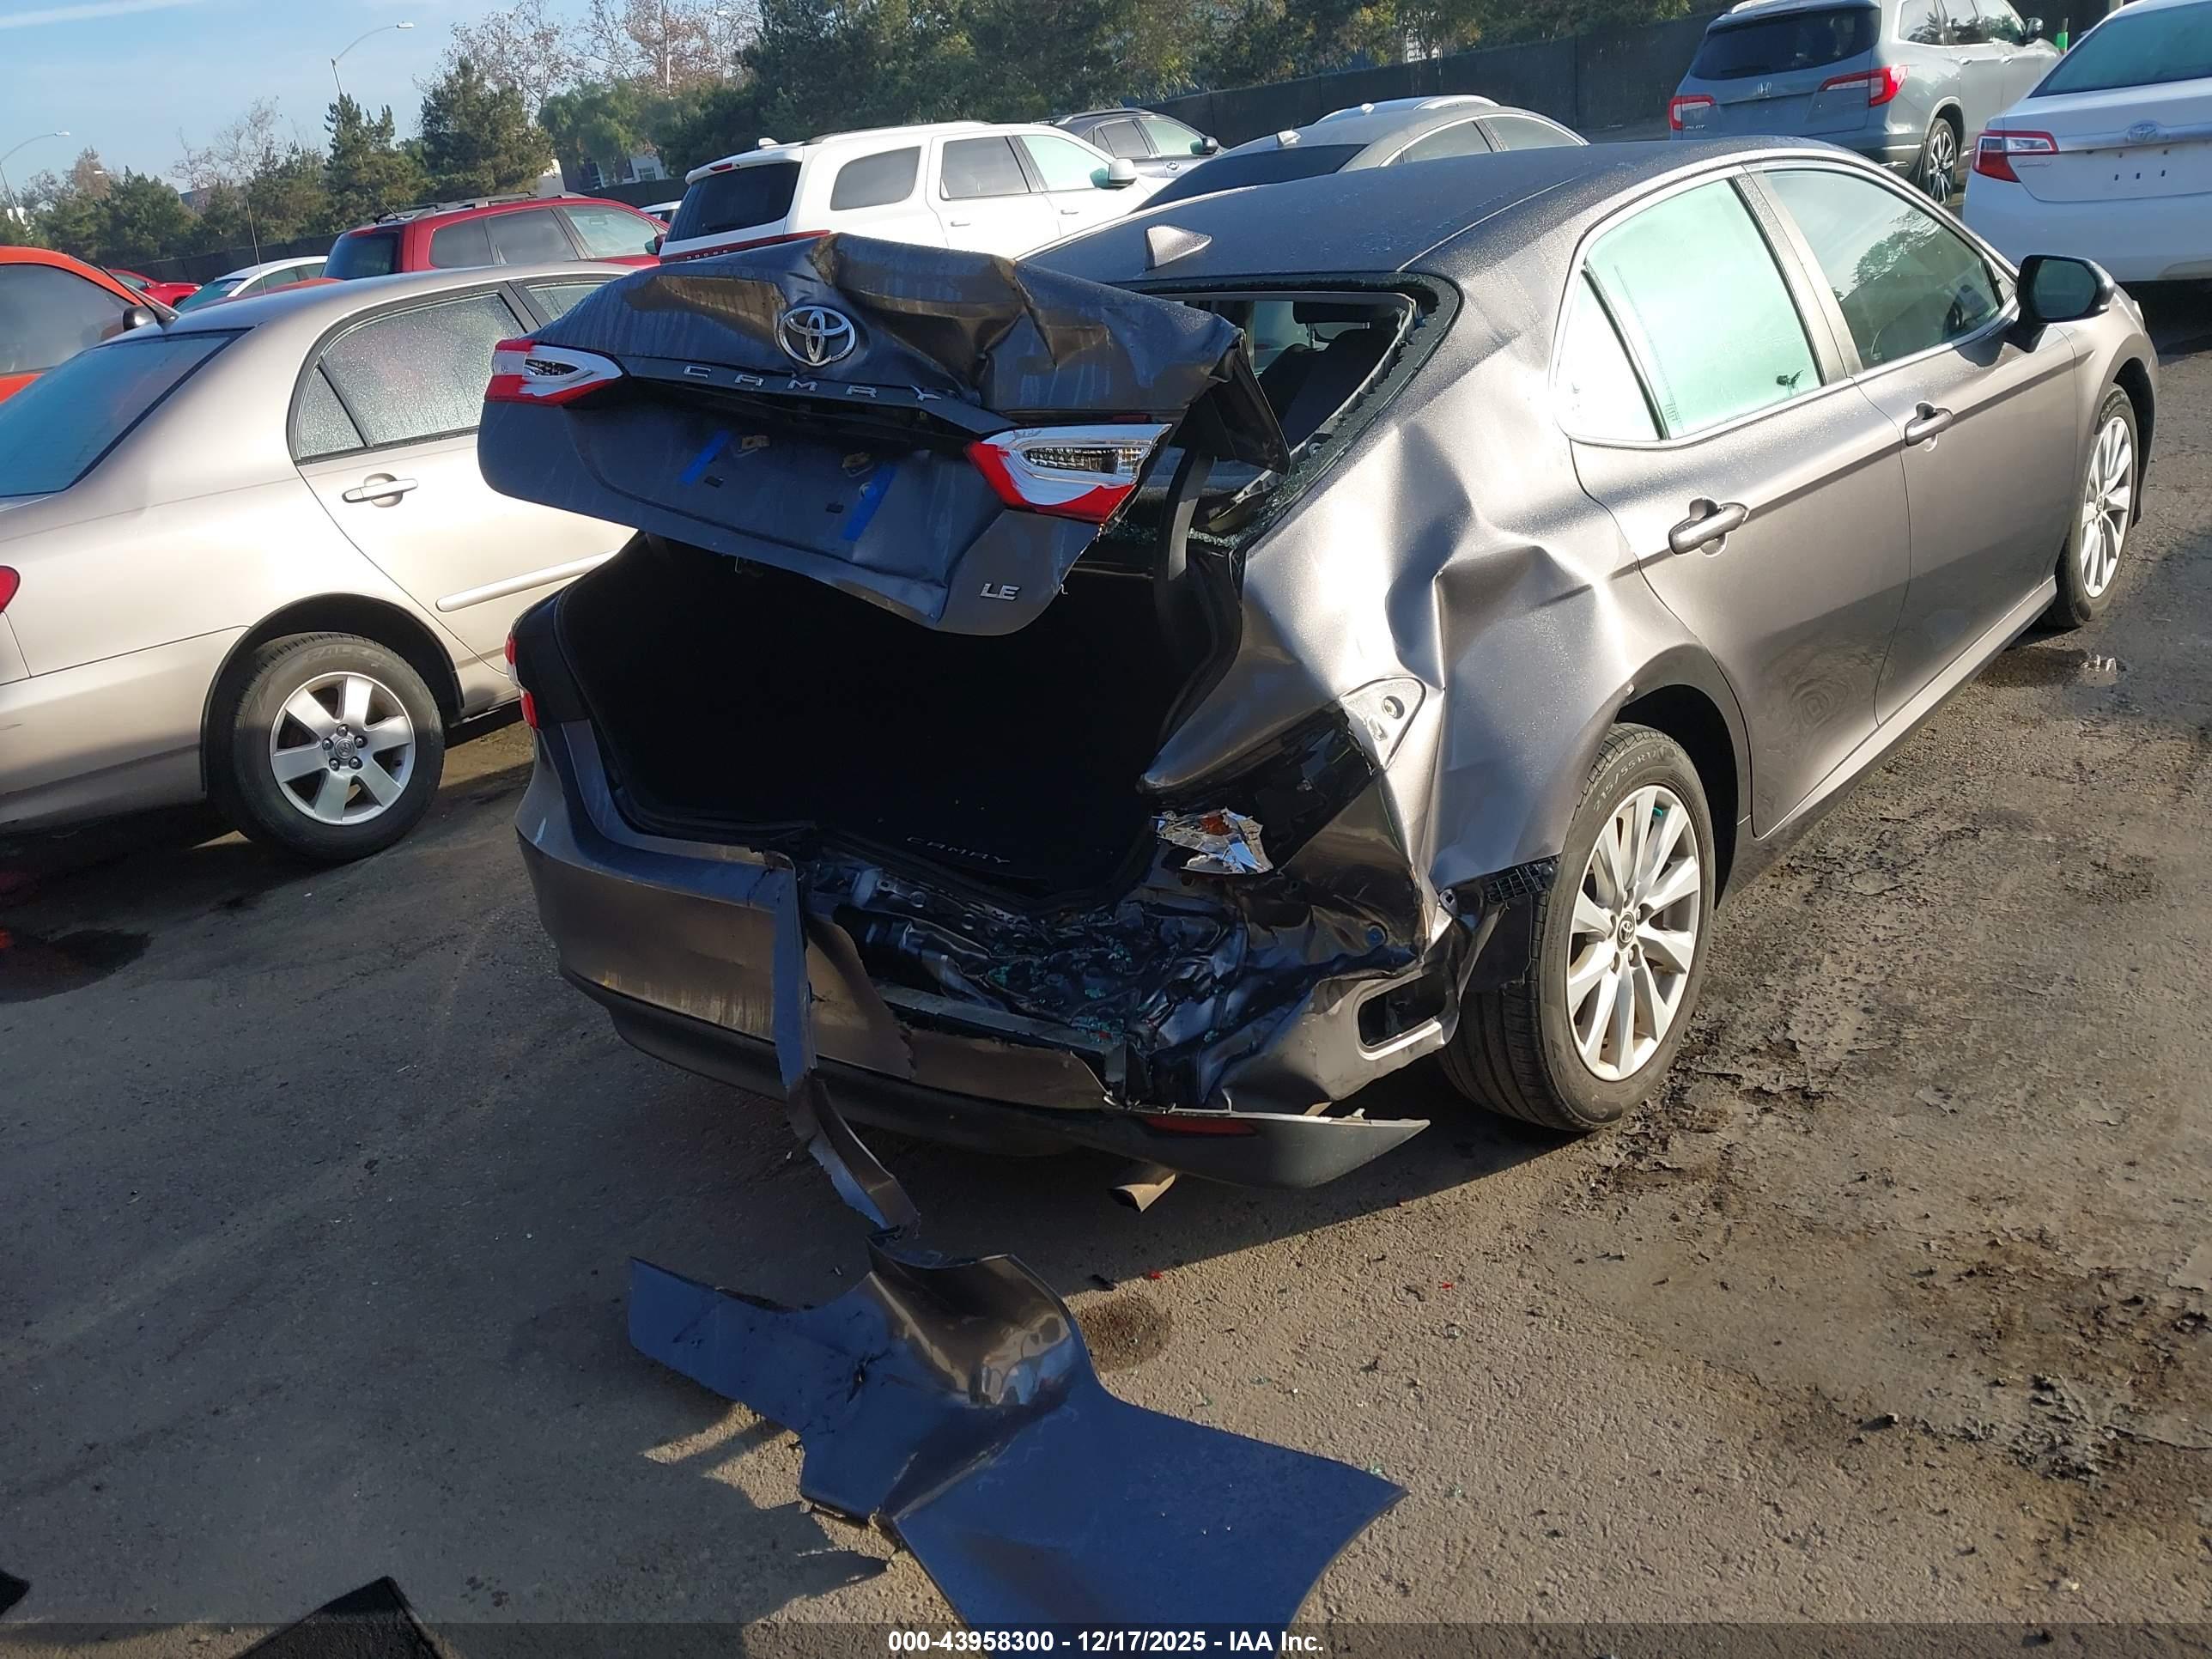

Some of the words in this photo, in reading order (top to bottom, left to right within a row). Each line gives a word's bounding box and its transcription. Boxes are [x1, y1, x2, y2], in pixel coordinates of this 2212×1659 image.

[684, 365, 942, 402] CAMRY
[980, 583, 1020, 601] LE
[1594, 761, 1636, 811] 215/55
[906, 836, 1011, 864] CAMRY
